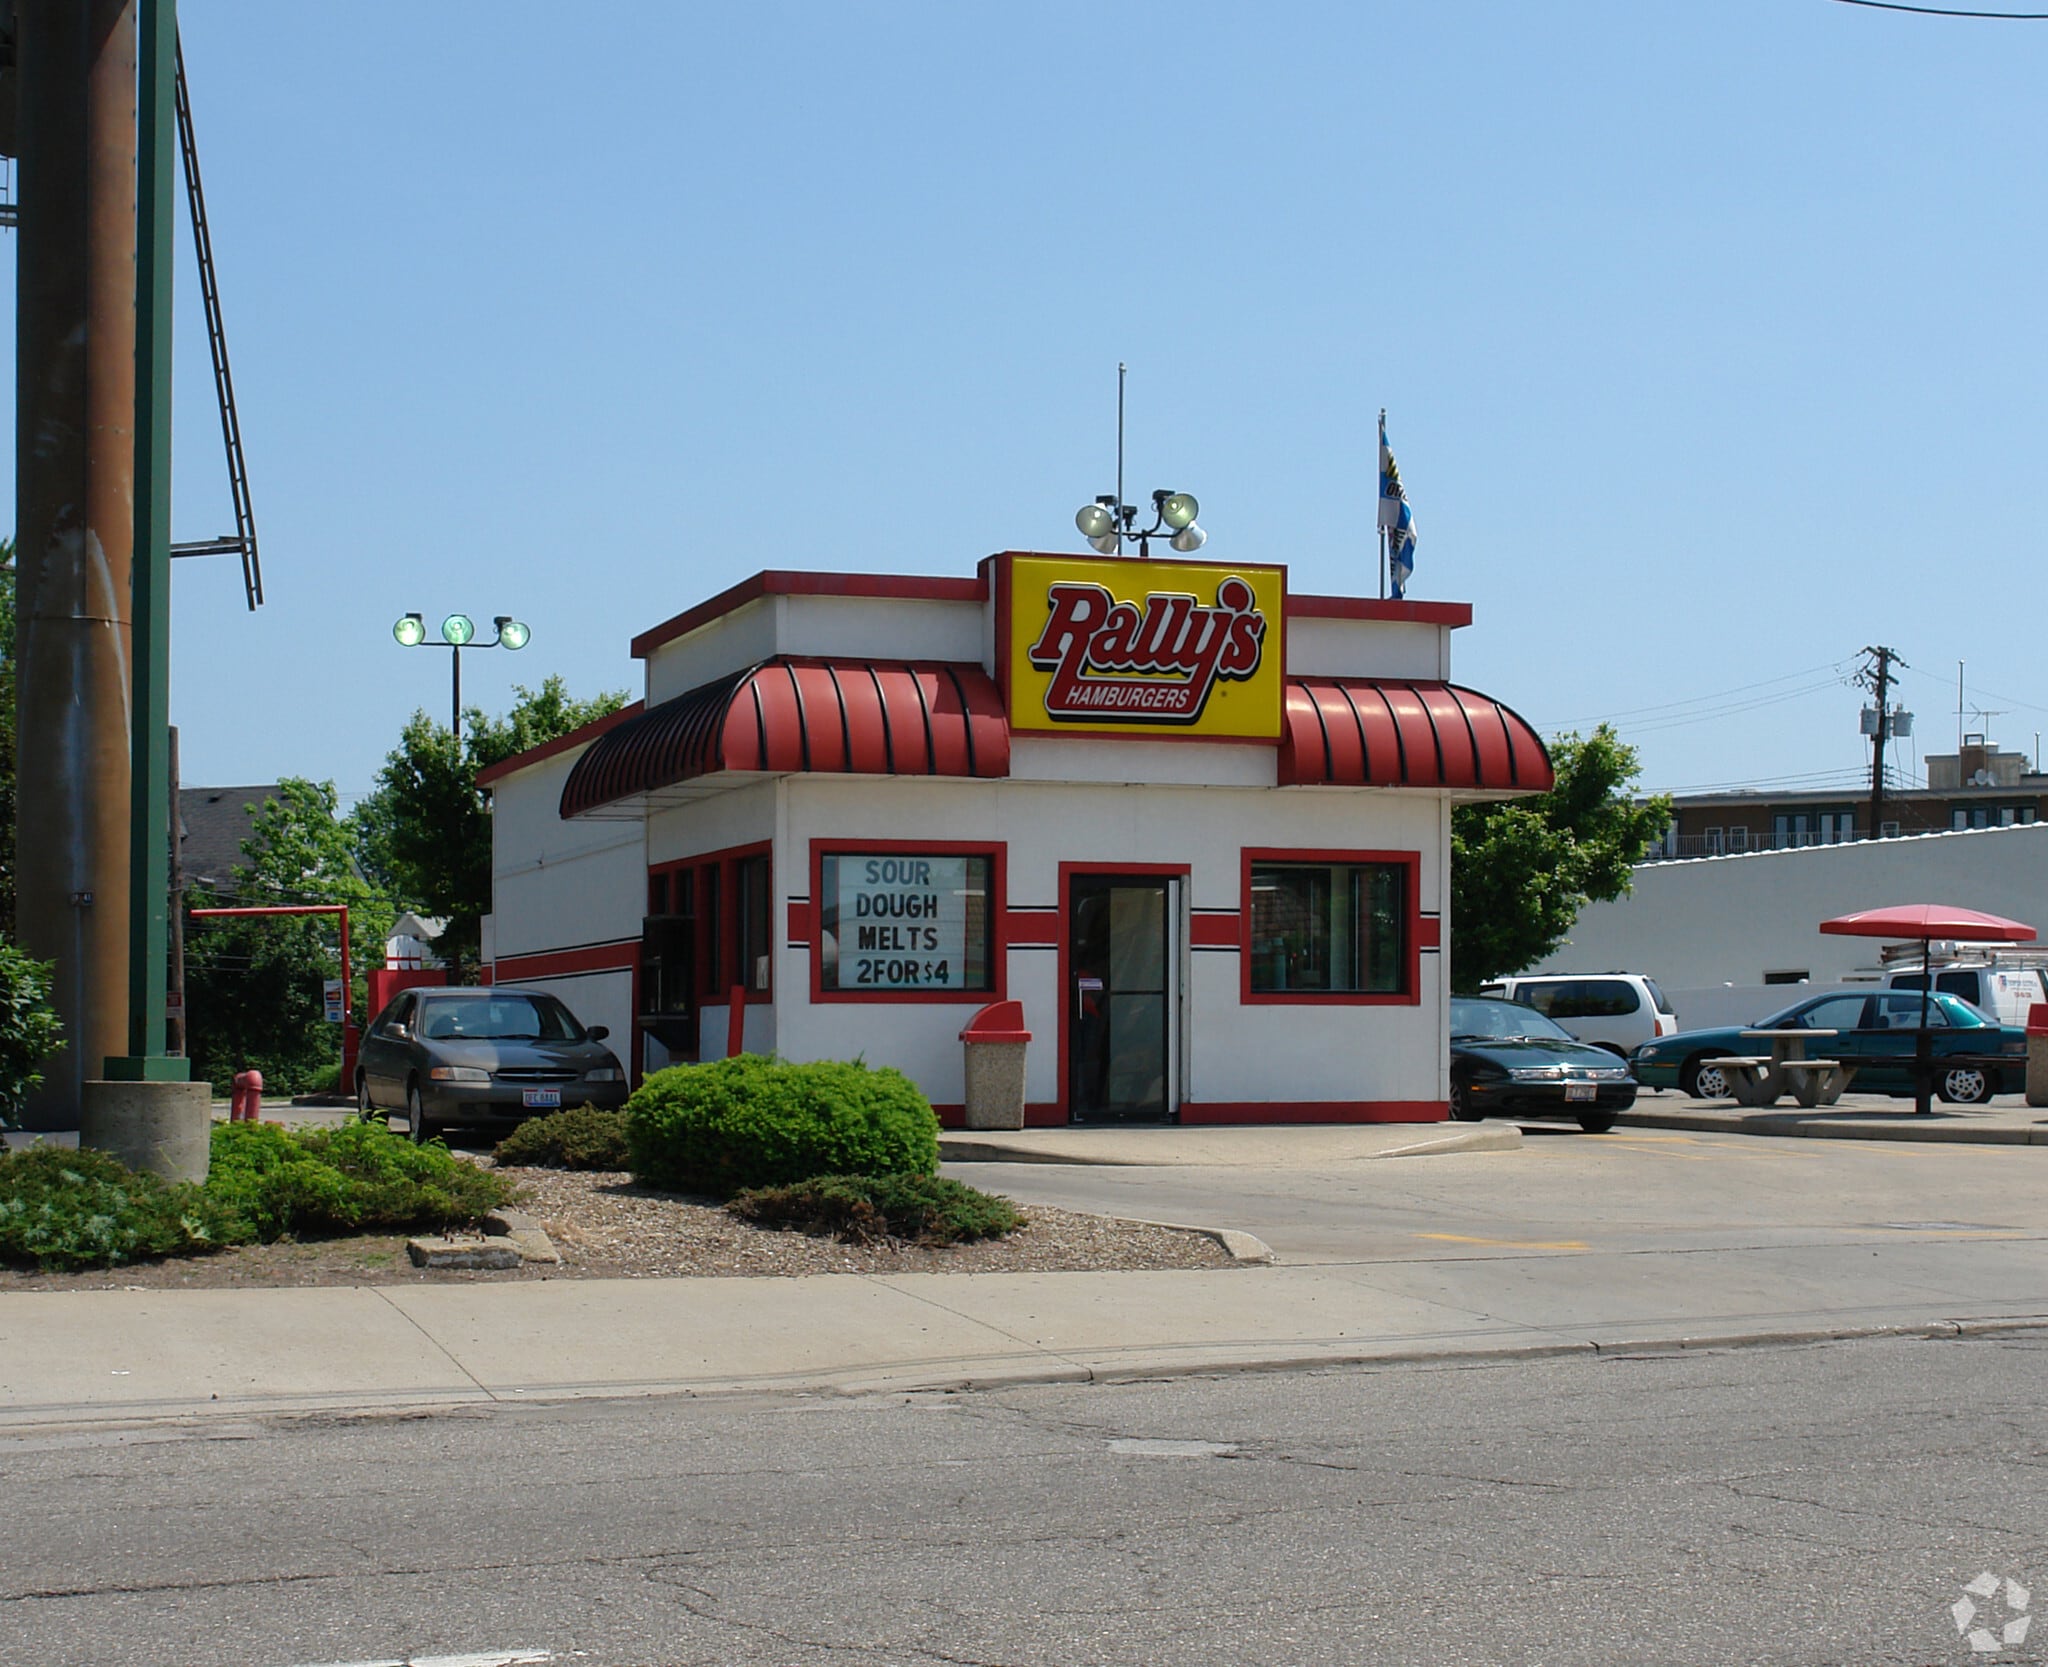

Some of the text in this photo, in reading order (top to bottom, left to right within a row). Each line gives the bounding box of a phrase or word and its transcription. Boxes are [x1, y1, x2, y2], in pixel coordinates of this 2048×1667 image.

[1029, 576, 1266, 690] Rally's
[1065, 685, 1190, 709] HAMBURGERS
[865, 860, 931, 886] SOUR
[856, 893, 938, 919] DOUGH
[858, 926, 938, 951] MELTS
